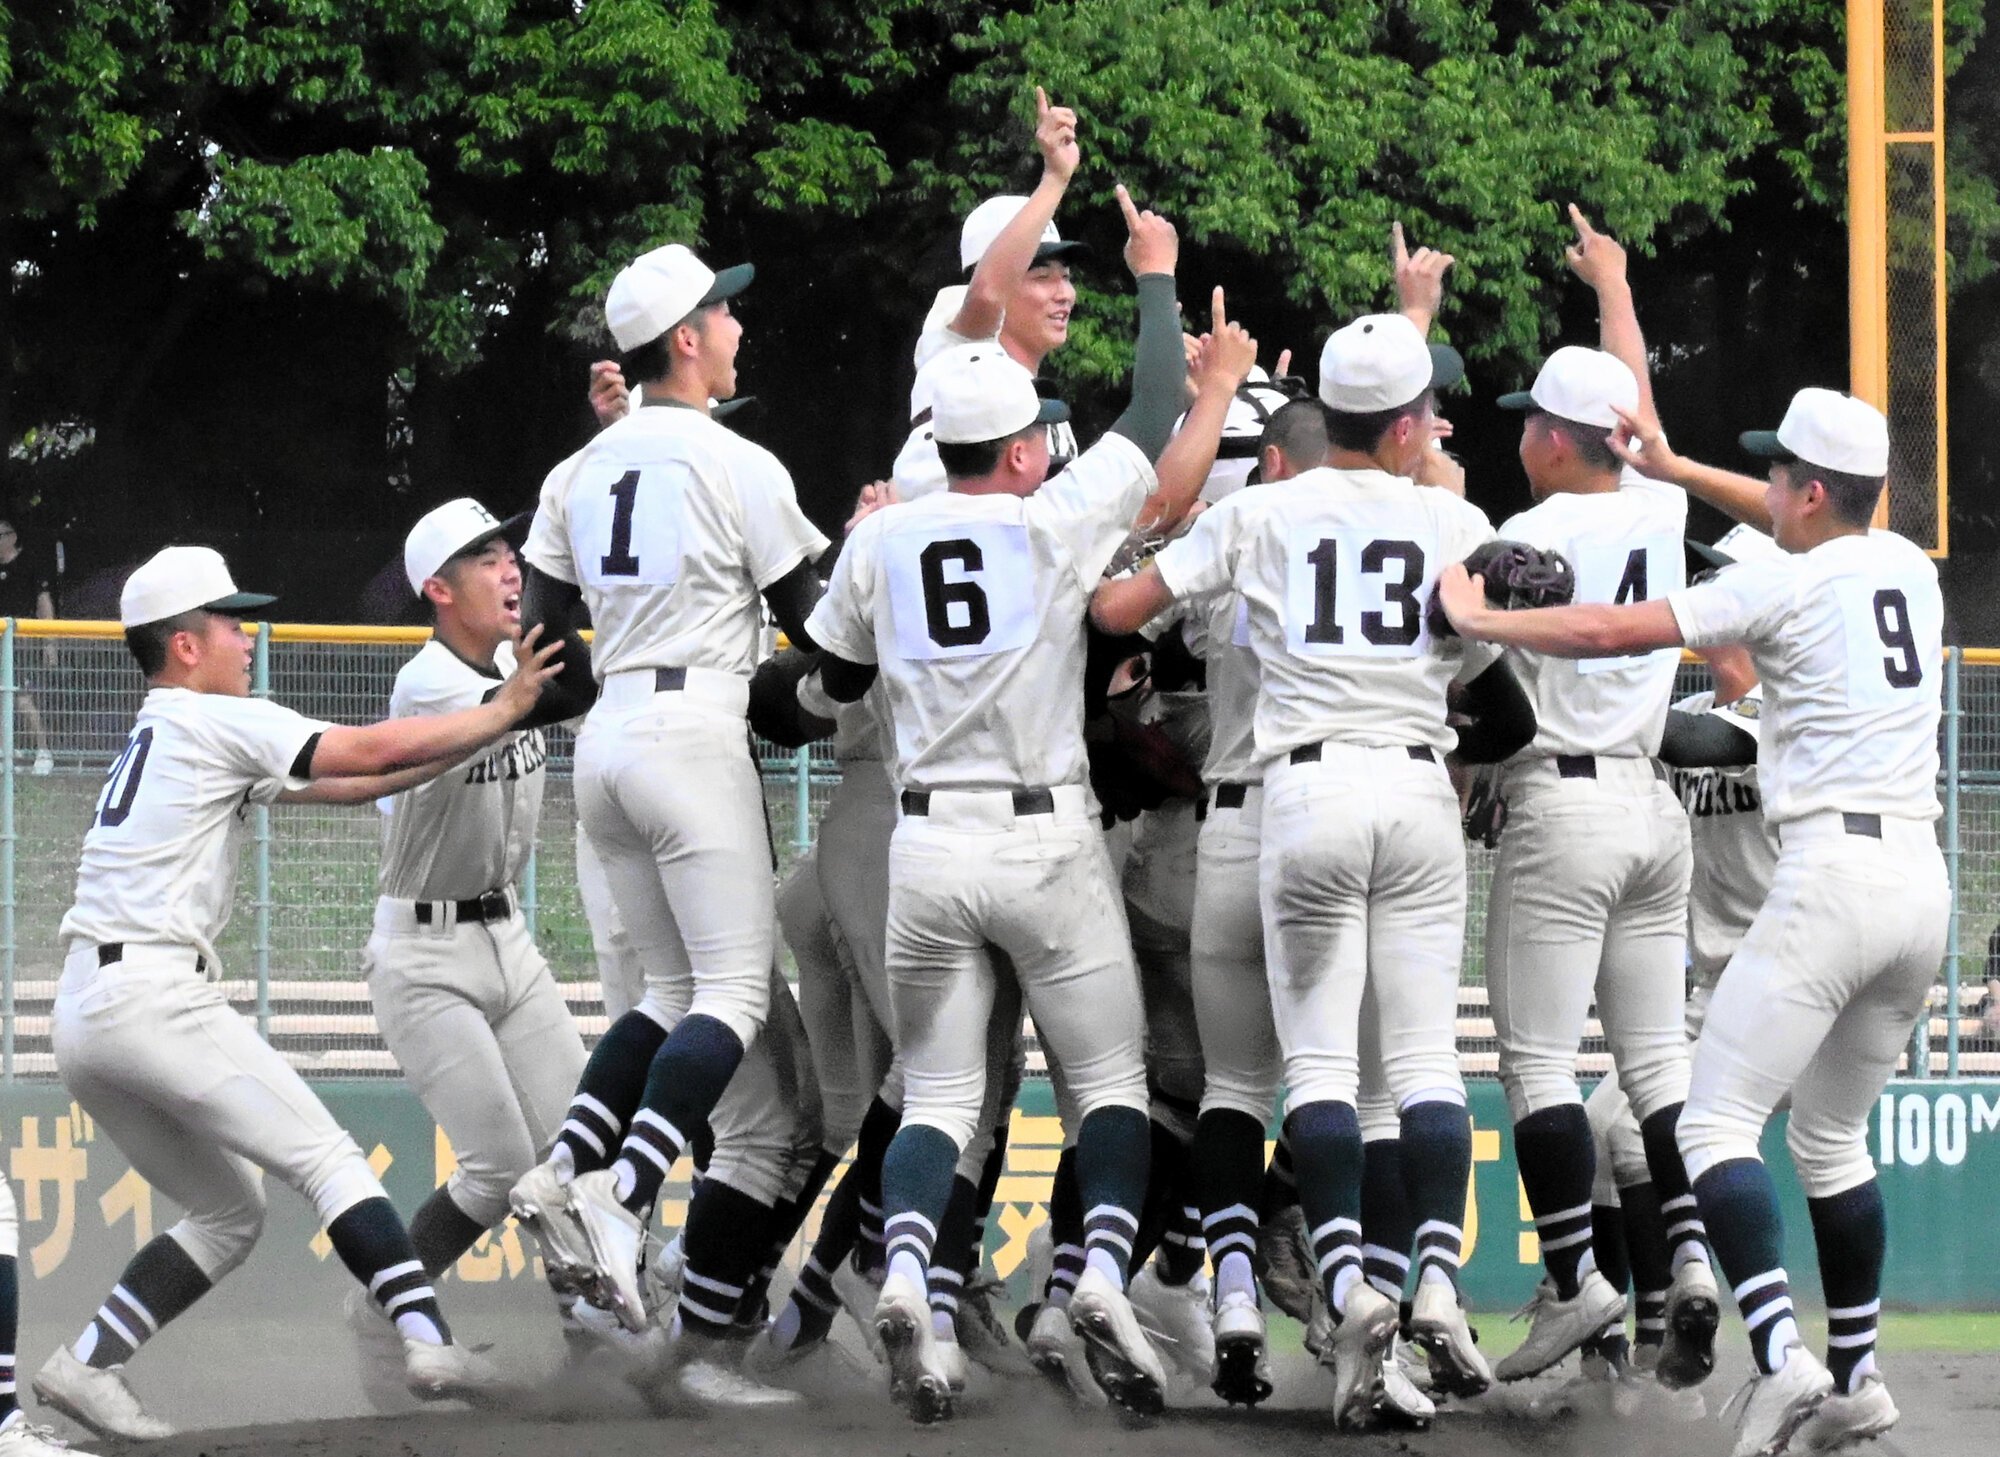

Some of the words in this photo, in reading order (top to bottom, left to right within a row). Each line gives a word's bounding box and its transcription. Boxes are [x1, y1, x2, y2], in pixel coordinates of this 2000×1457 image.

[601, 470, 641, 576] 1
[919, 538, 991, 649] 6
[1304, 538, 1426, 646] 13
[1872, 589, 1923, 689] 9
